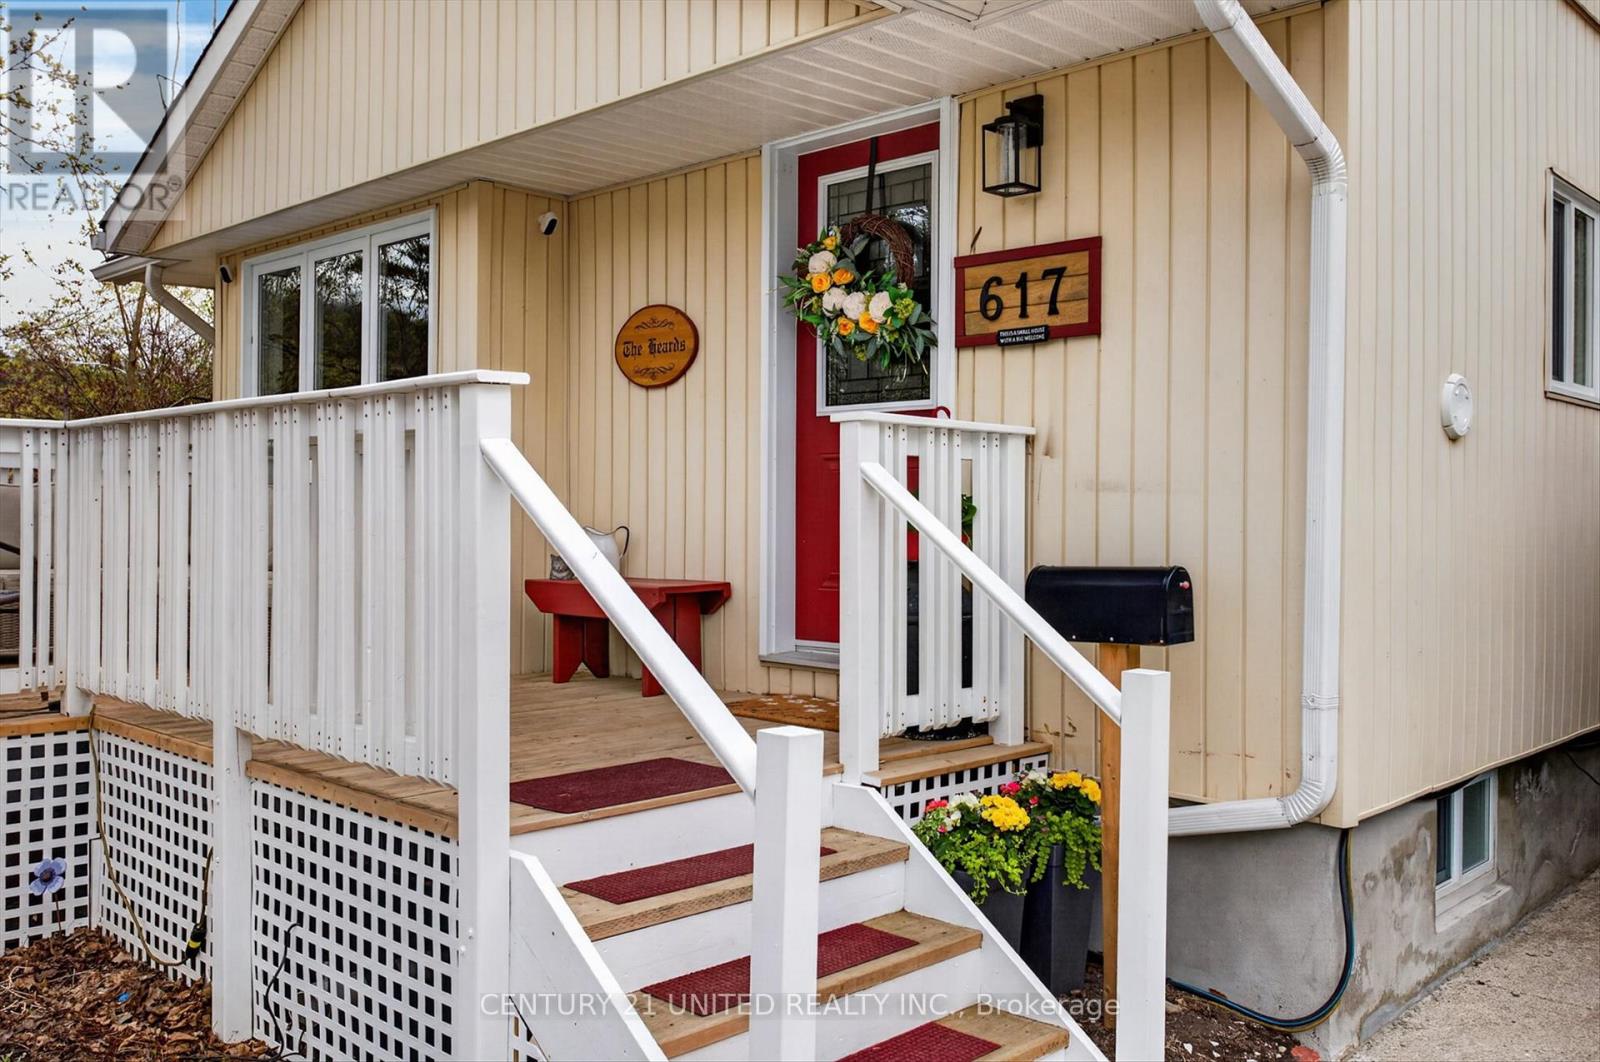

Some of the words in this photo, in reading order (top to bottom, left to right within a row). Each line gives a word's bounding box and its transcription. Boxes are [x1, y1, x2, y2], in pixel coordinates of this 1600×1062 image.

[979, 266, 1068, 322] 617
[623, 340, 643, 359] The
[648, 337, 686, 358] Heards
